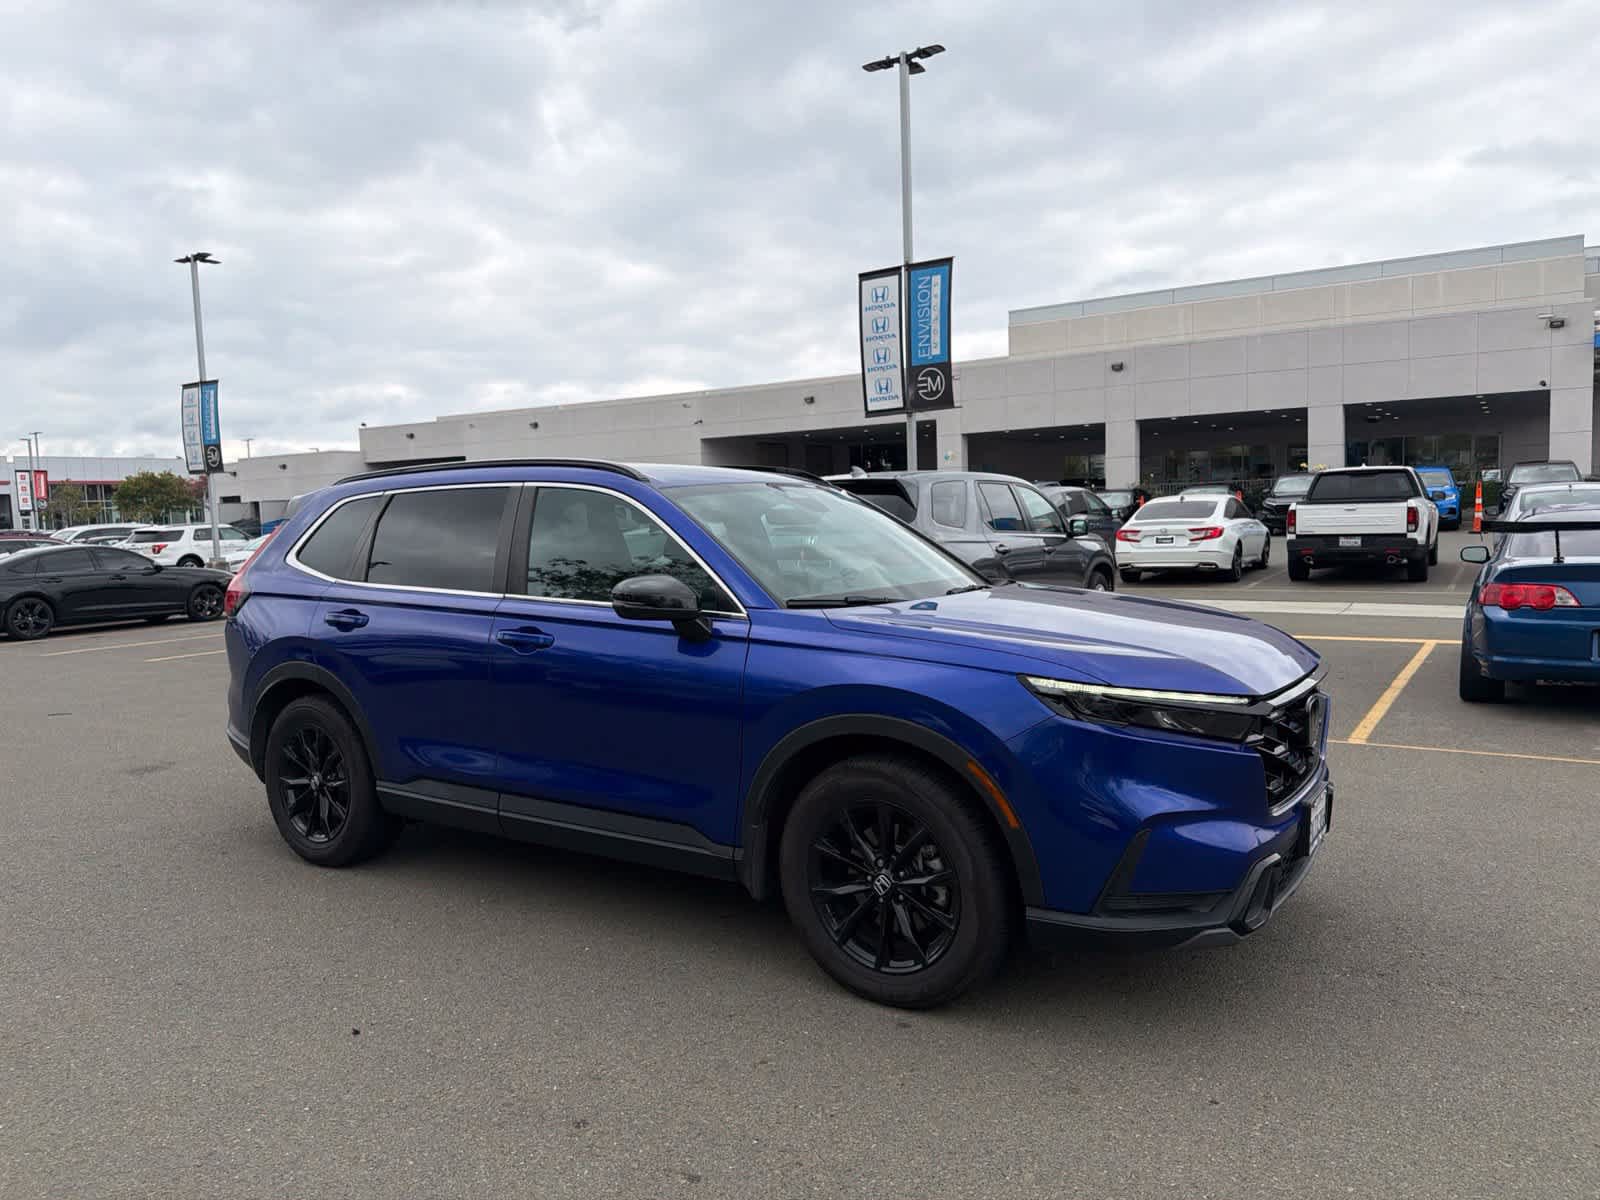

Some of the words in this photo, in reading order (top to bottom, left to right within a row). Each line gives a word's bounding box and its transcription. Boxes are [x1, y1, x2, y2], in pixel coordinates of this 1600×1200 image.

[865, 302, 896, 312] HONDA
[917, 275, 931, 358] ENVISION
[866, 333, 897, 343] HONDA
